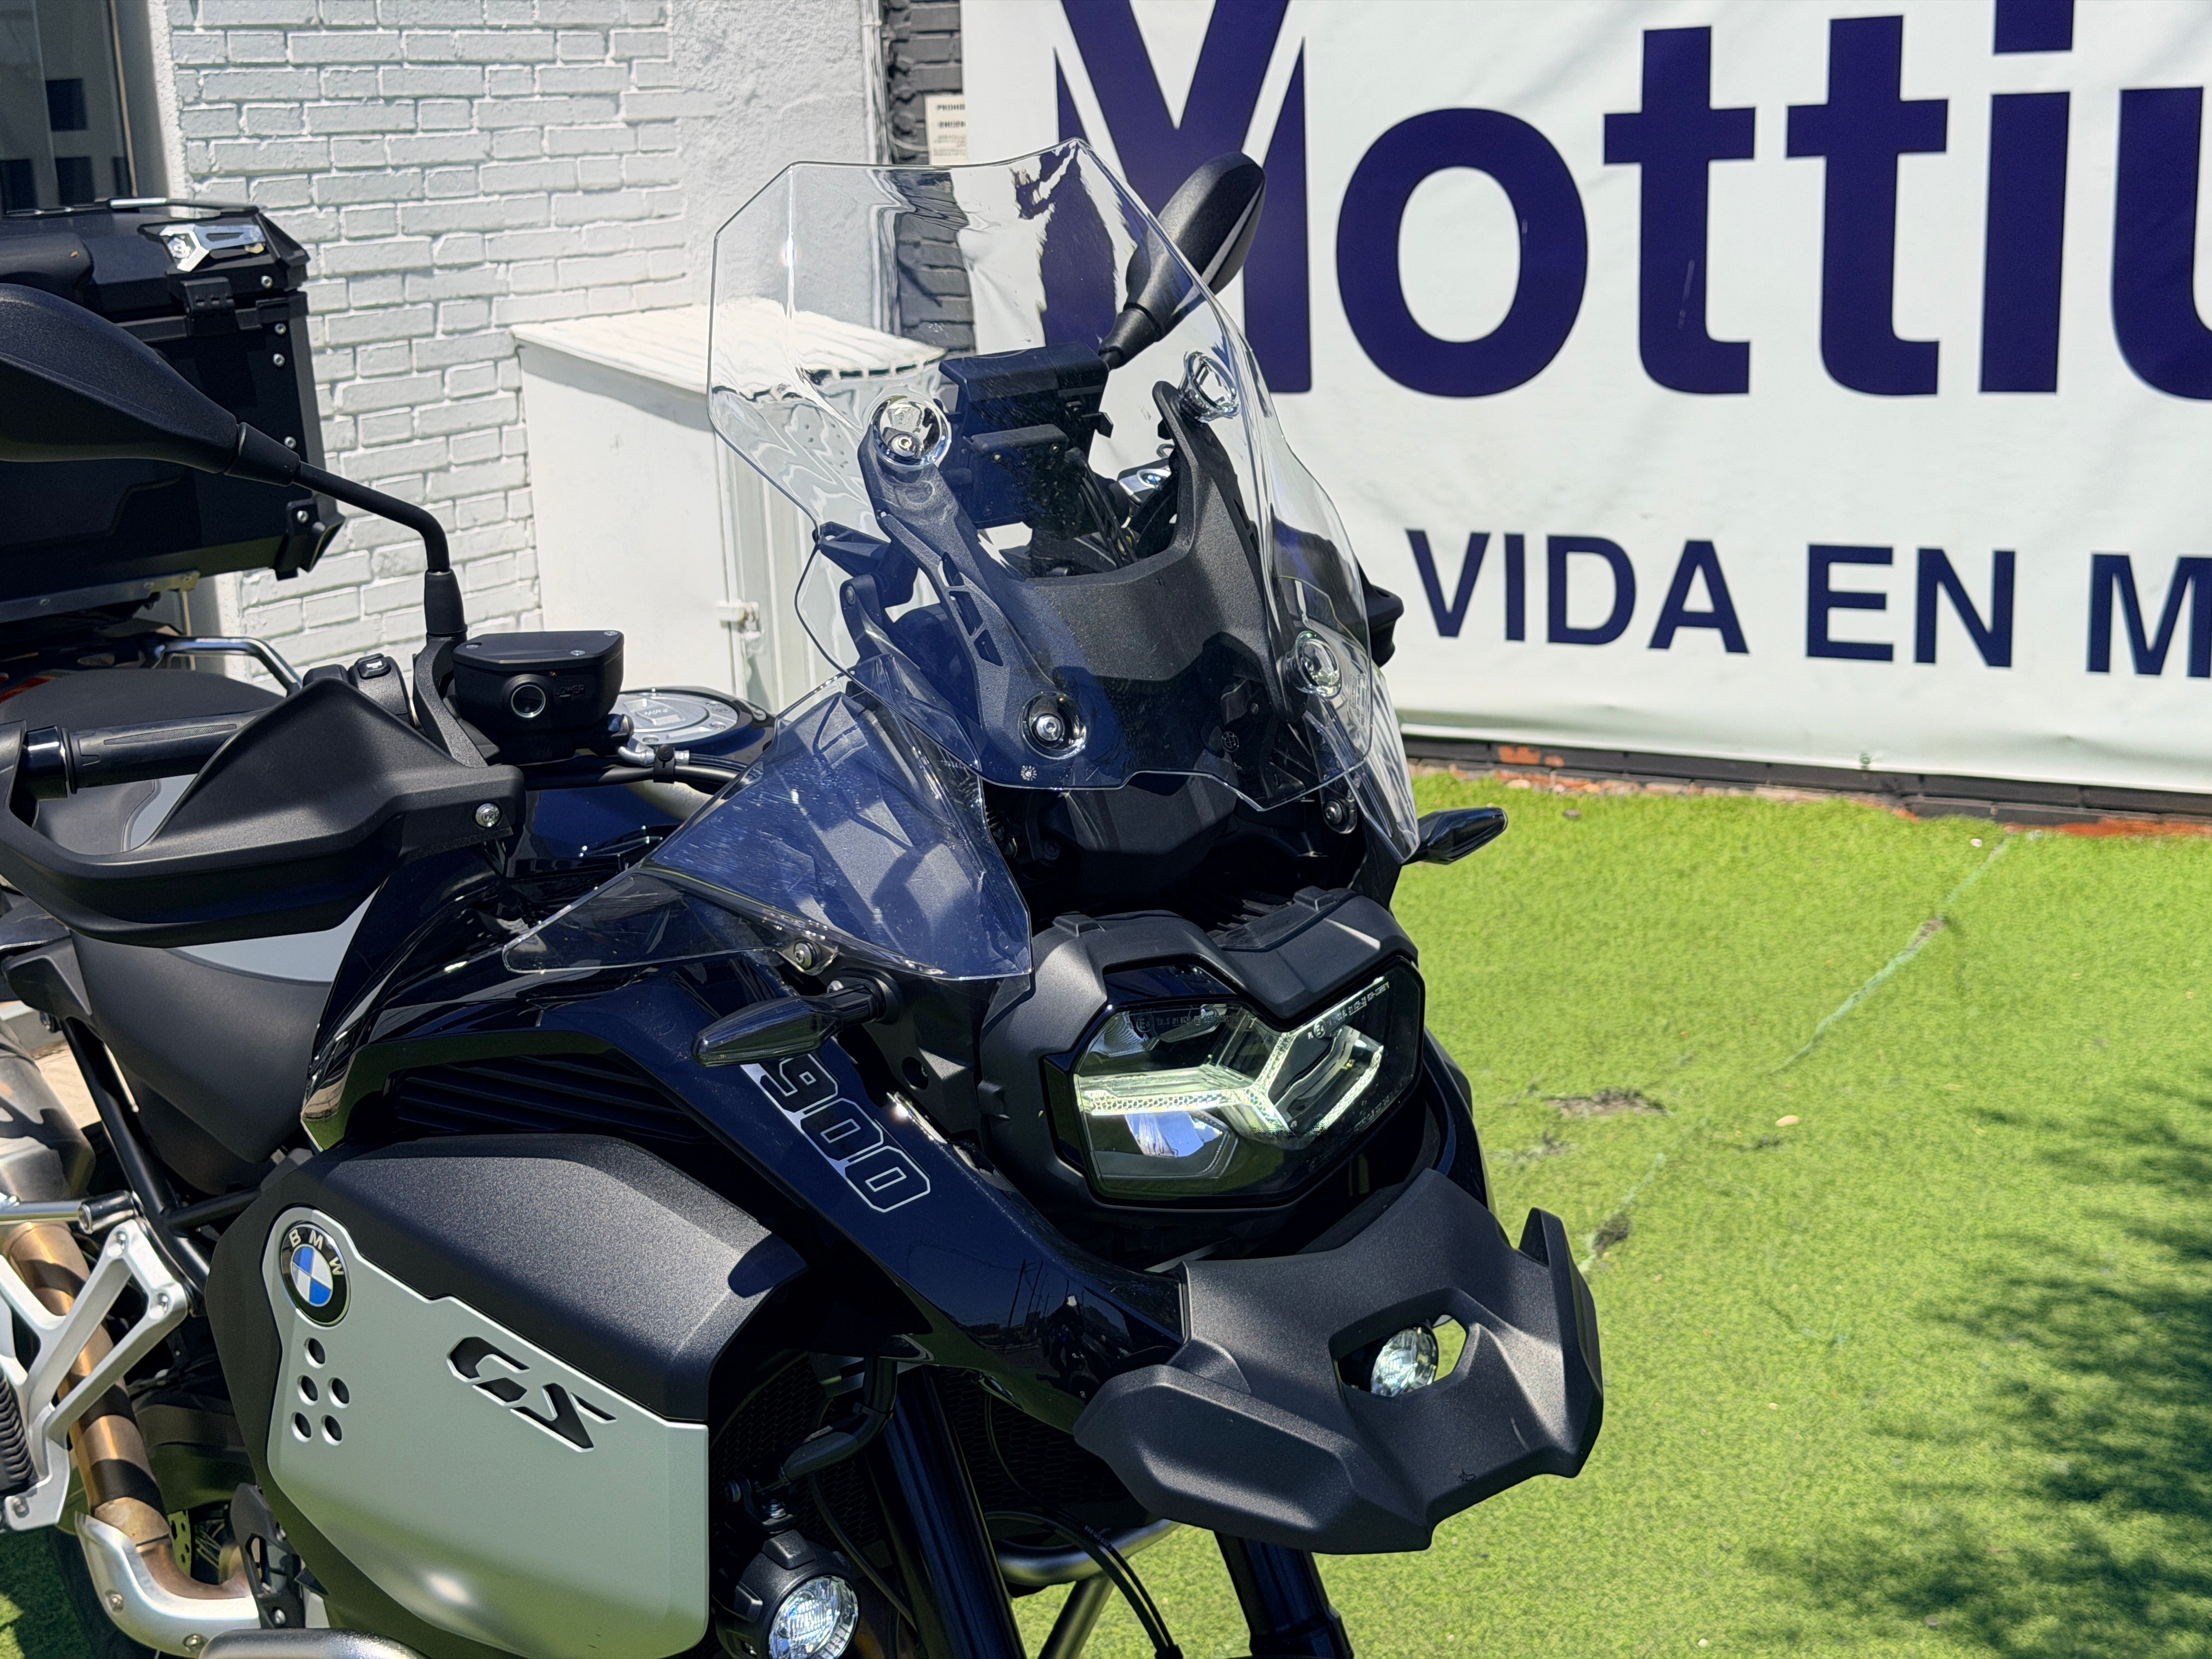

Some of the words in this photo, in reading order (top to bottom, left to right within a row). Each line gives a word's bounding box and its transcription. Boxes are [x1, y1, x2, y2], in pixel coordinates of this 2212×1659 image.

[1405, 529, 1750, 655] VIDA
[1805, 543, 2016, 668] EN
[2085, 552, 2212, 678] M
[747, 1053, 931, 1213] 900
[289, 1228, 345, 1275] BMW
[447, 1336, 617, 1452] GS
